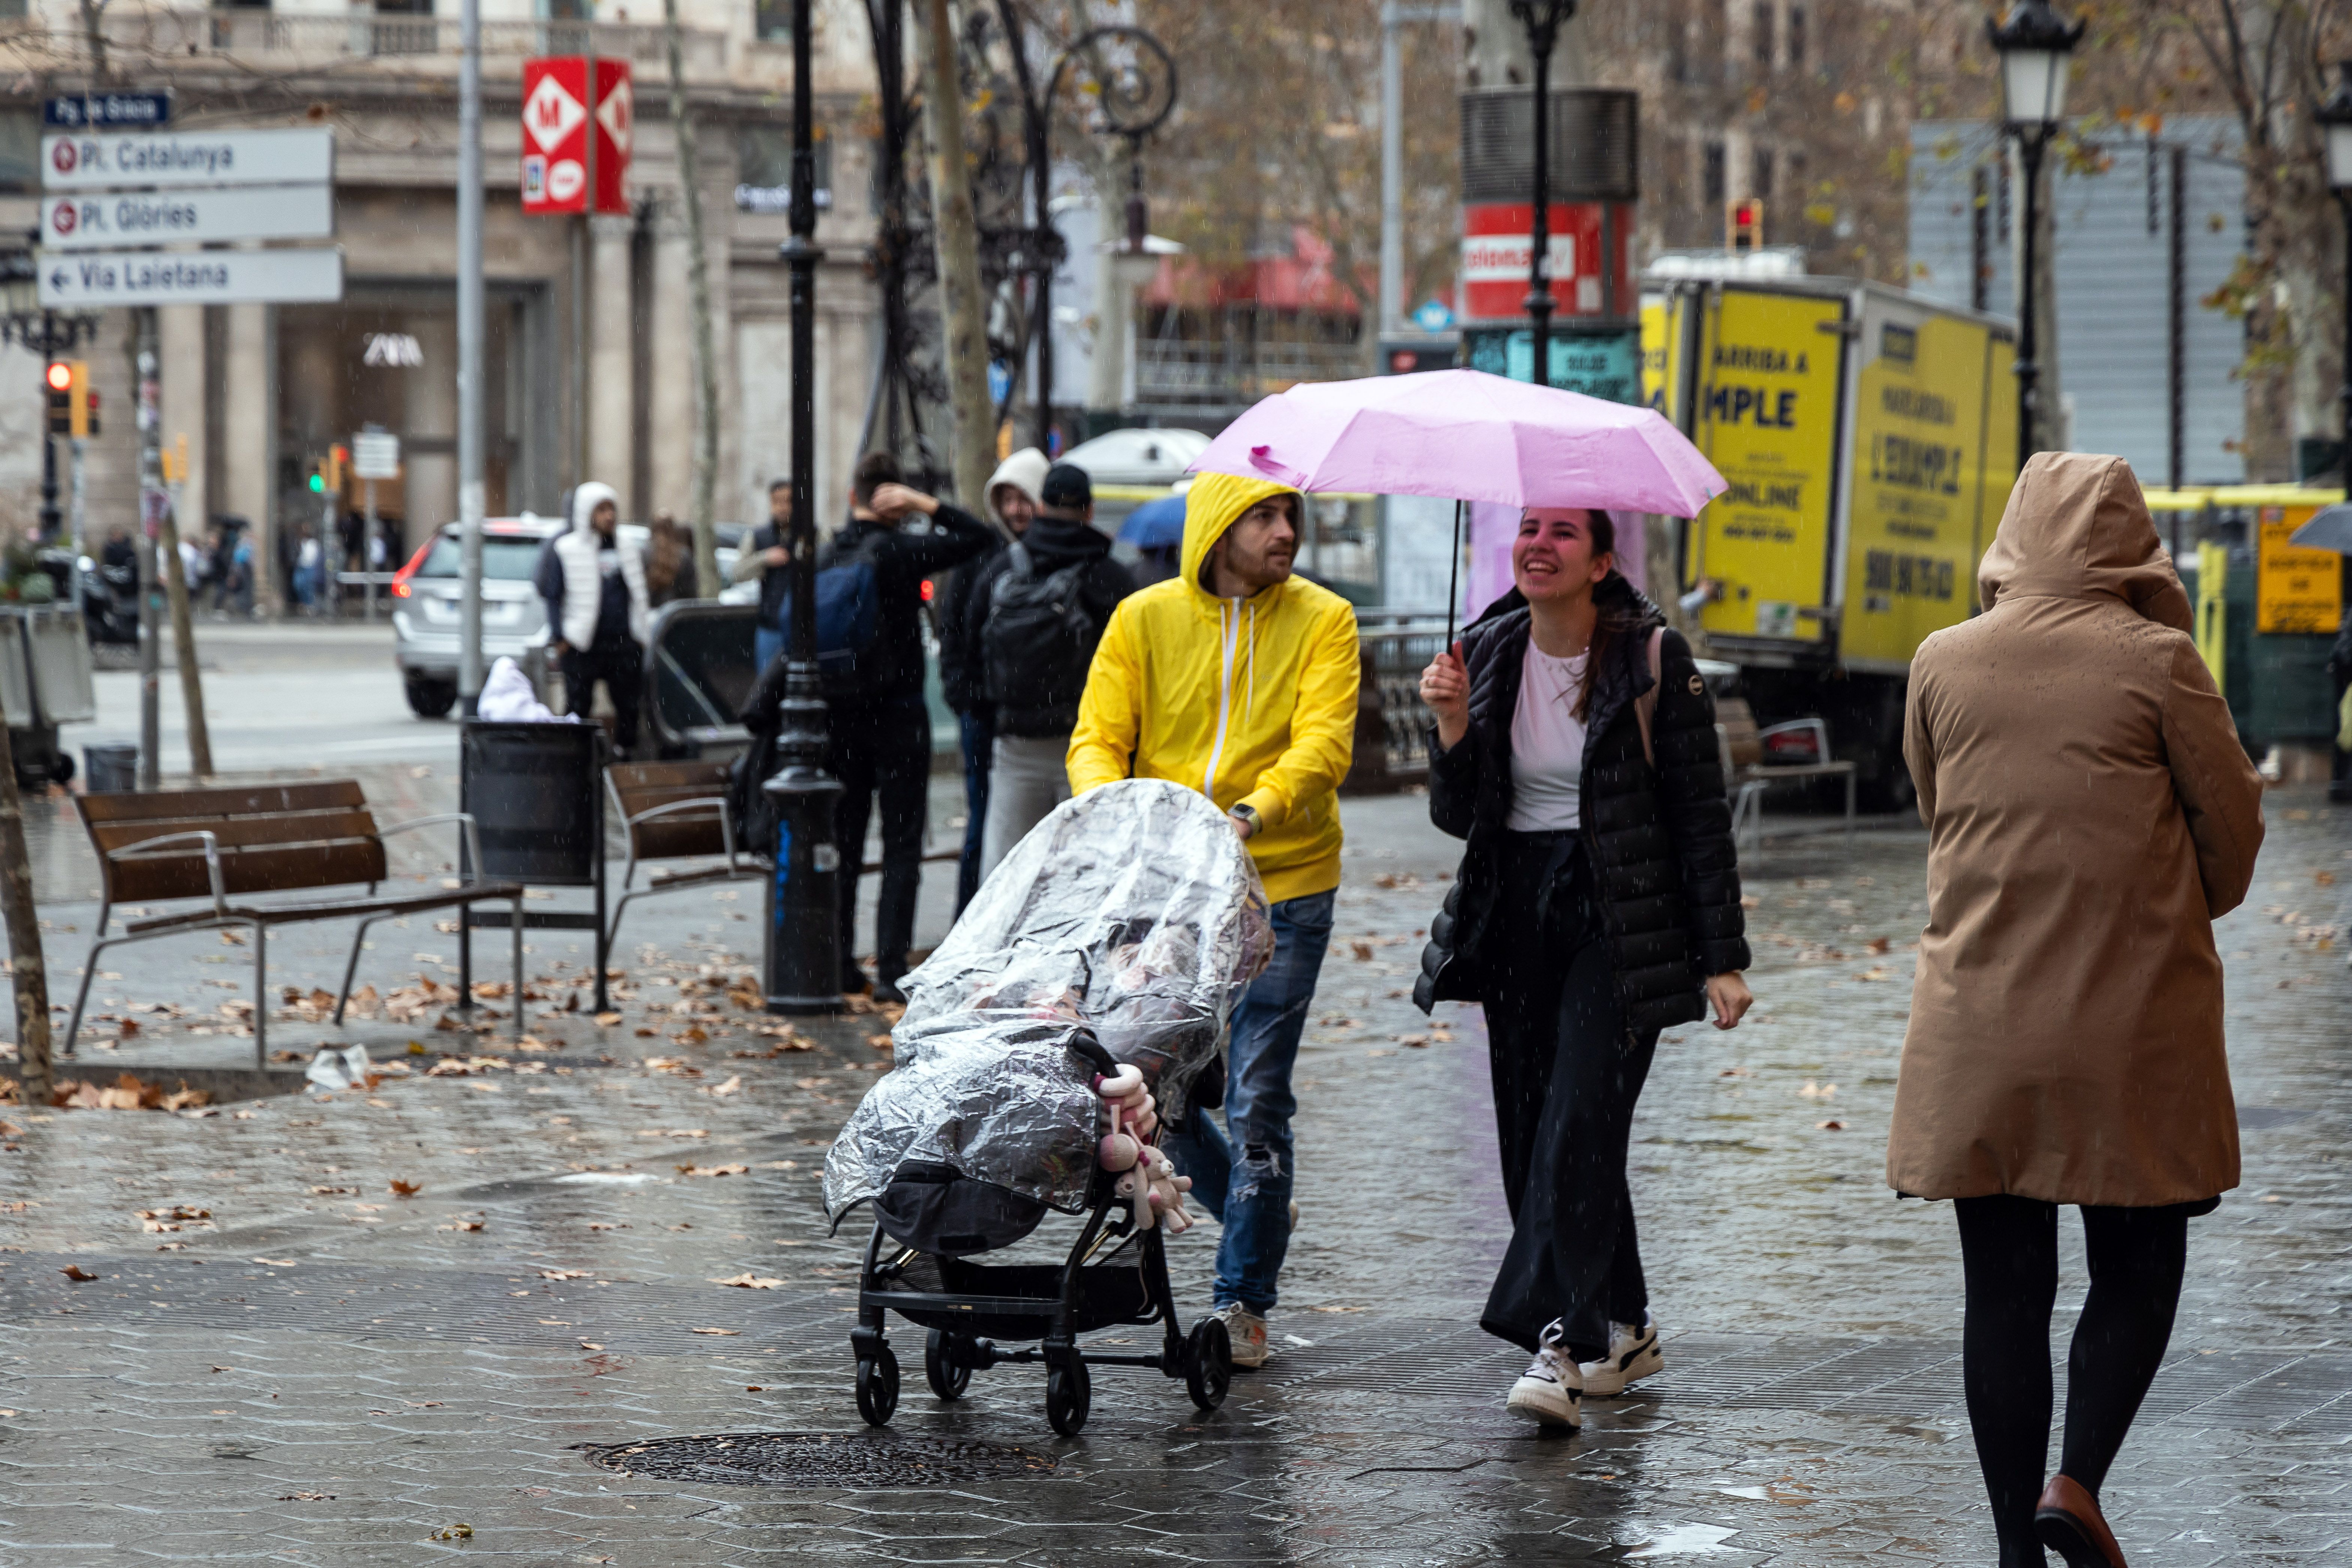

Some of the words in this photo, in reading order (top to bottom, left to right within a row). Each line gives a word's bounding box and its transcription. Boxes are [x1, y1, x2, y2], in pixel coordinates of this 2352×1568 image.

[539, 98, 559, 127] M
[81, 139, 108, 172] Pl.
[116, 137, 234, 174] Catalunya
[81, 202, 108, 231] Pl.
[78, 258, 115, 291] Via
[124, 257, 228, 289] Laietana
